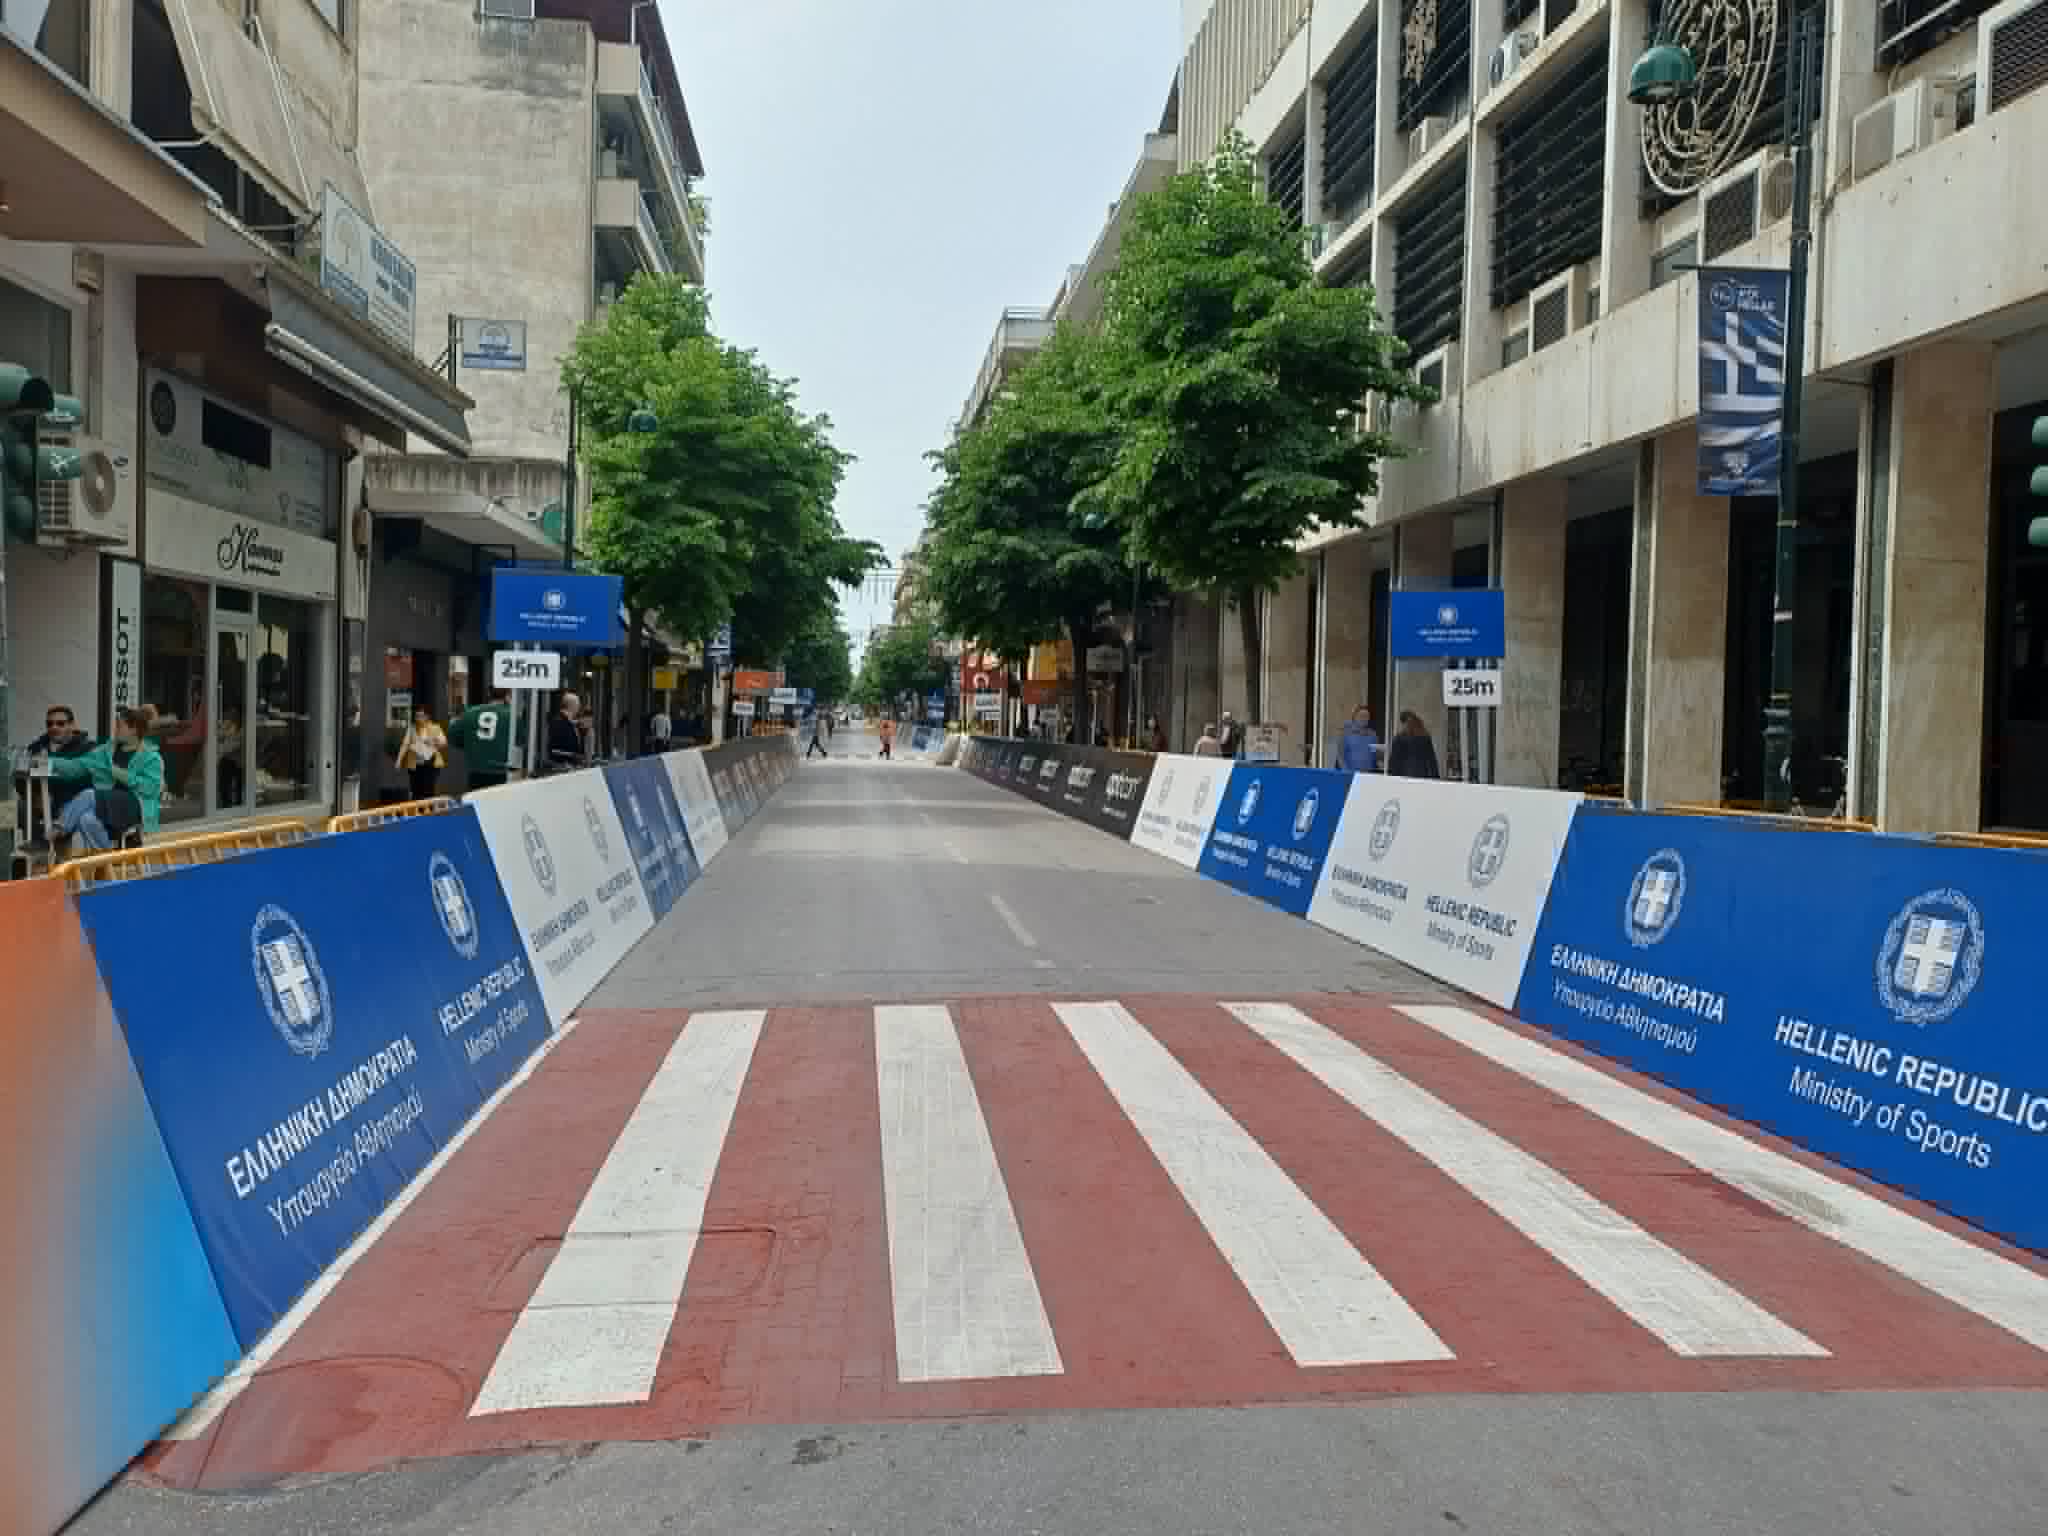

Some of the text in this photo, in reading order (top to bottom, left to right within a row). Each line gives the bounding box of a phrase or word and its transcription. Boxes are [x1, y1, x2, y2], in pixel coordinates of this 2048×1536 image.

[501, 657, 550, 679] 25m
[1450, 677, 1495, 697] 25m
[476, 711, 499, 741] 9
[1426, 894, 1517, 937] HELLENIC REPUBLIC
[1551, 943, 1726, 1024] ΕΛΛΗΝΙΚΗ ΔΗΜΟΚΡΑΤΙΑ
[1614, 1001, 1698, 1053] Αθλητισμού
[1774, 1015, 2048, 1132] HELLENIC REPUBLIC
[225, 1031, 419, 1201] ΕΛΛΗΝΙΚΗ ΔΗΜΟΚΡΑΤΙΑ
[1789, 1064, 1992, 1169] Ministry of Sports
[266, 1081, 424, 1241] Υπουργείο Αθλητισμού
